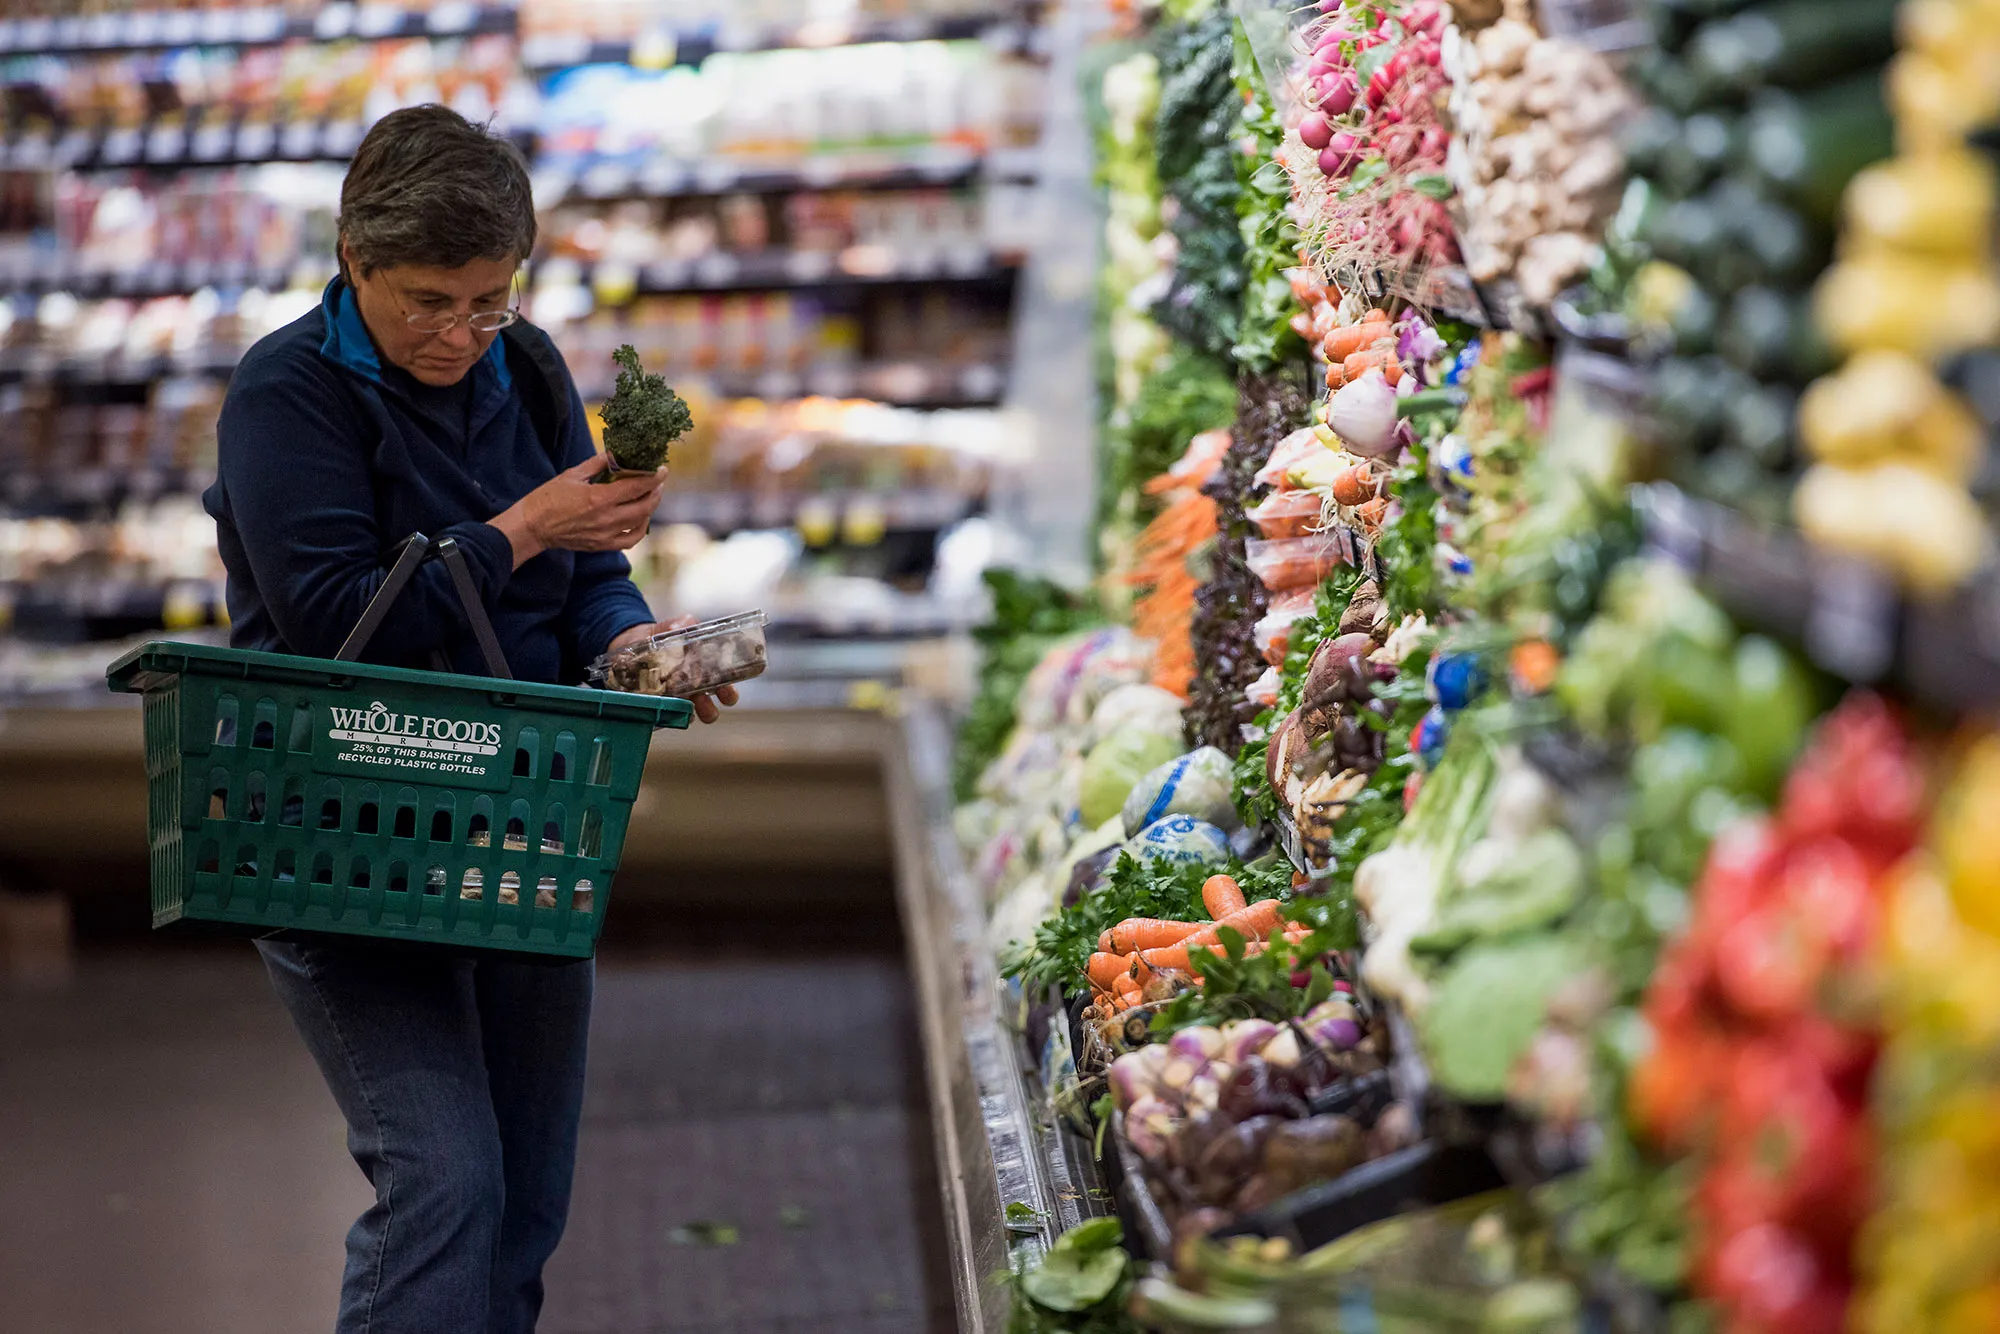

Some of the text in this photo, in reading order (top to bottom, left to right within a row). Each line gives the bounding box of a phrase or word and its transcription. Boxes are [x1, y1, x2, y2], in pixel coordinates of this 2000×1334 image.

[330, 704, 501, 745] WHOLE FOODS
[346, 732, 484, 753] MARKET
[352, 743, 473, 763] 25% OF THIS BASKET IS
[338, 753, 486, 775] RECYCLED PLASTIC BOTTLES
